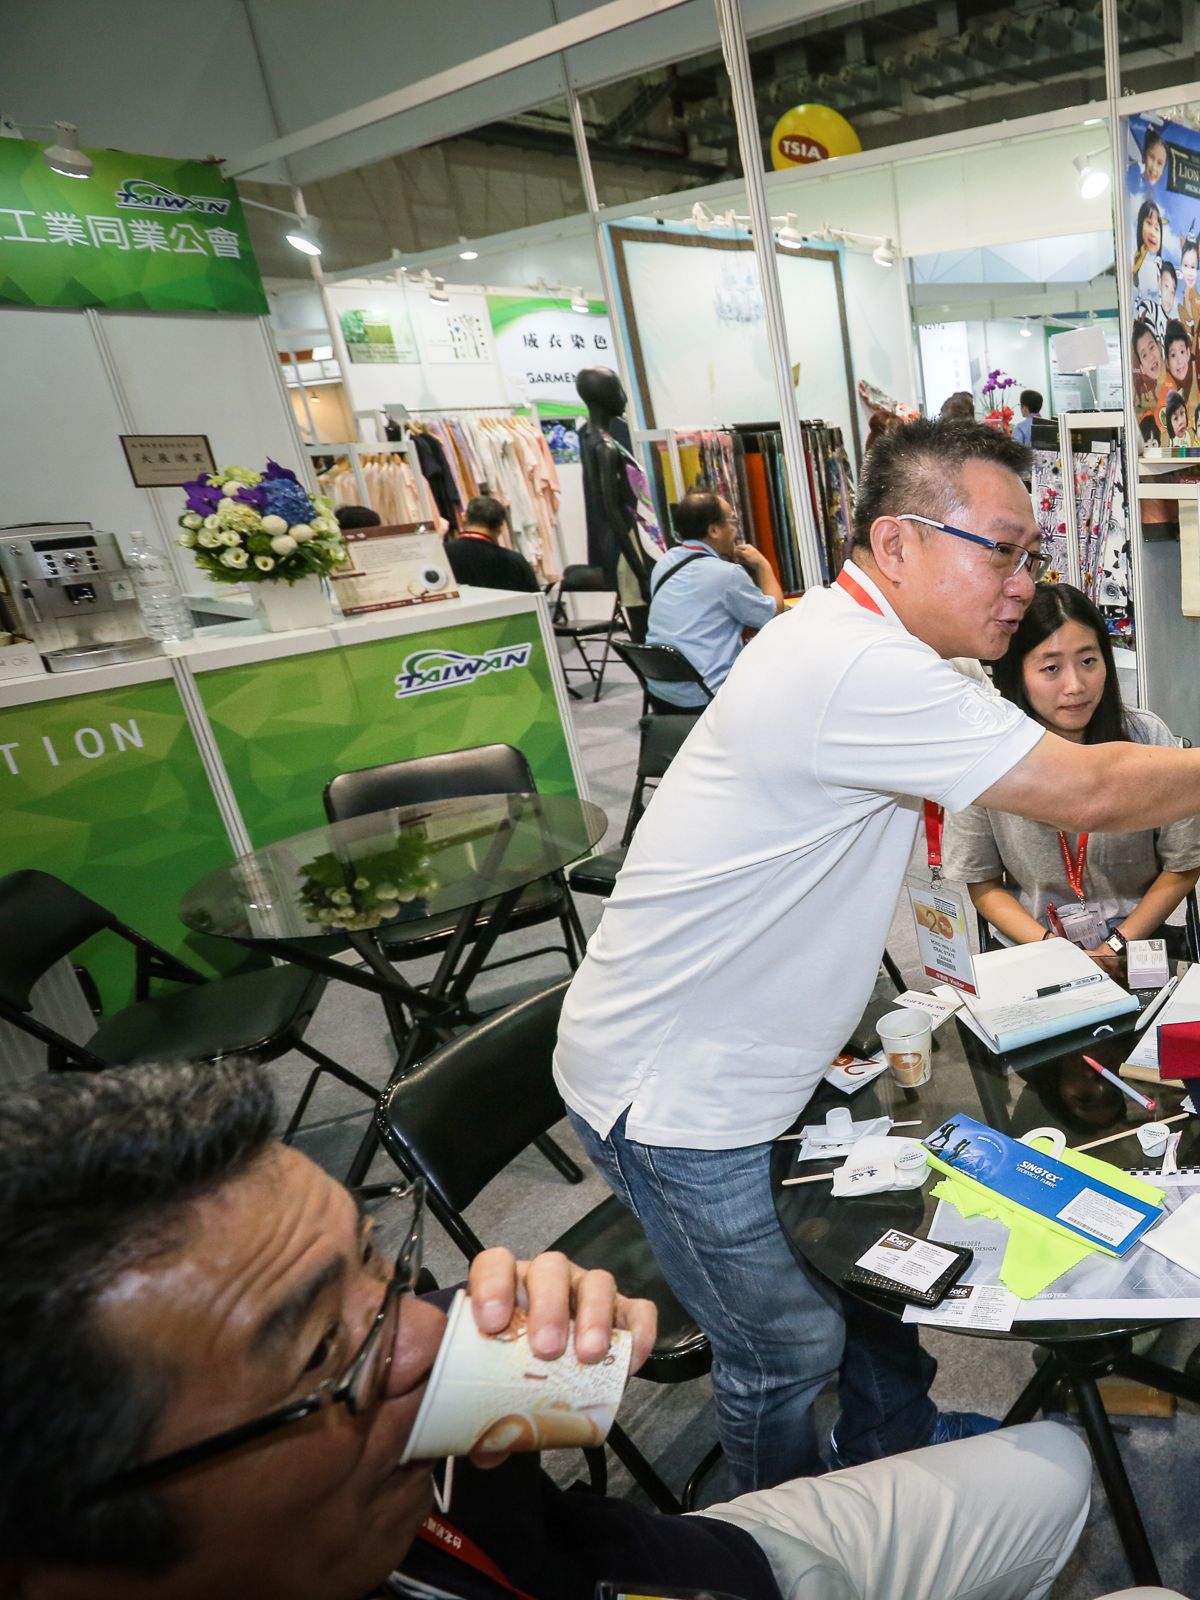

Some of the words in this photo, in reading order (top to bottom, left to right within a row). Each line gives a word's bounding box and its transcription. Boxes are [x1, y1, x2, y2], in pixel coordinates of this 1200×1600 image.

[782, 140, 821, 160] TSIA
[1179, 163, 1200, 181] LION
[116, 185, 229, 214] TAIWAN
[0, 208, 241, 260] 工業同業公會
[522, 333, 608, 350] 成衣染色
[399, 646, 530, 694] TAIWAN
[1015, 1166, 1040, 1180] TECHNICAL
[1039, 1177, 1057, 1188] FABRIC
[1019, 1160, 1061, 1183] SINGTEX
